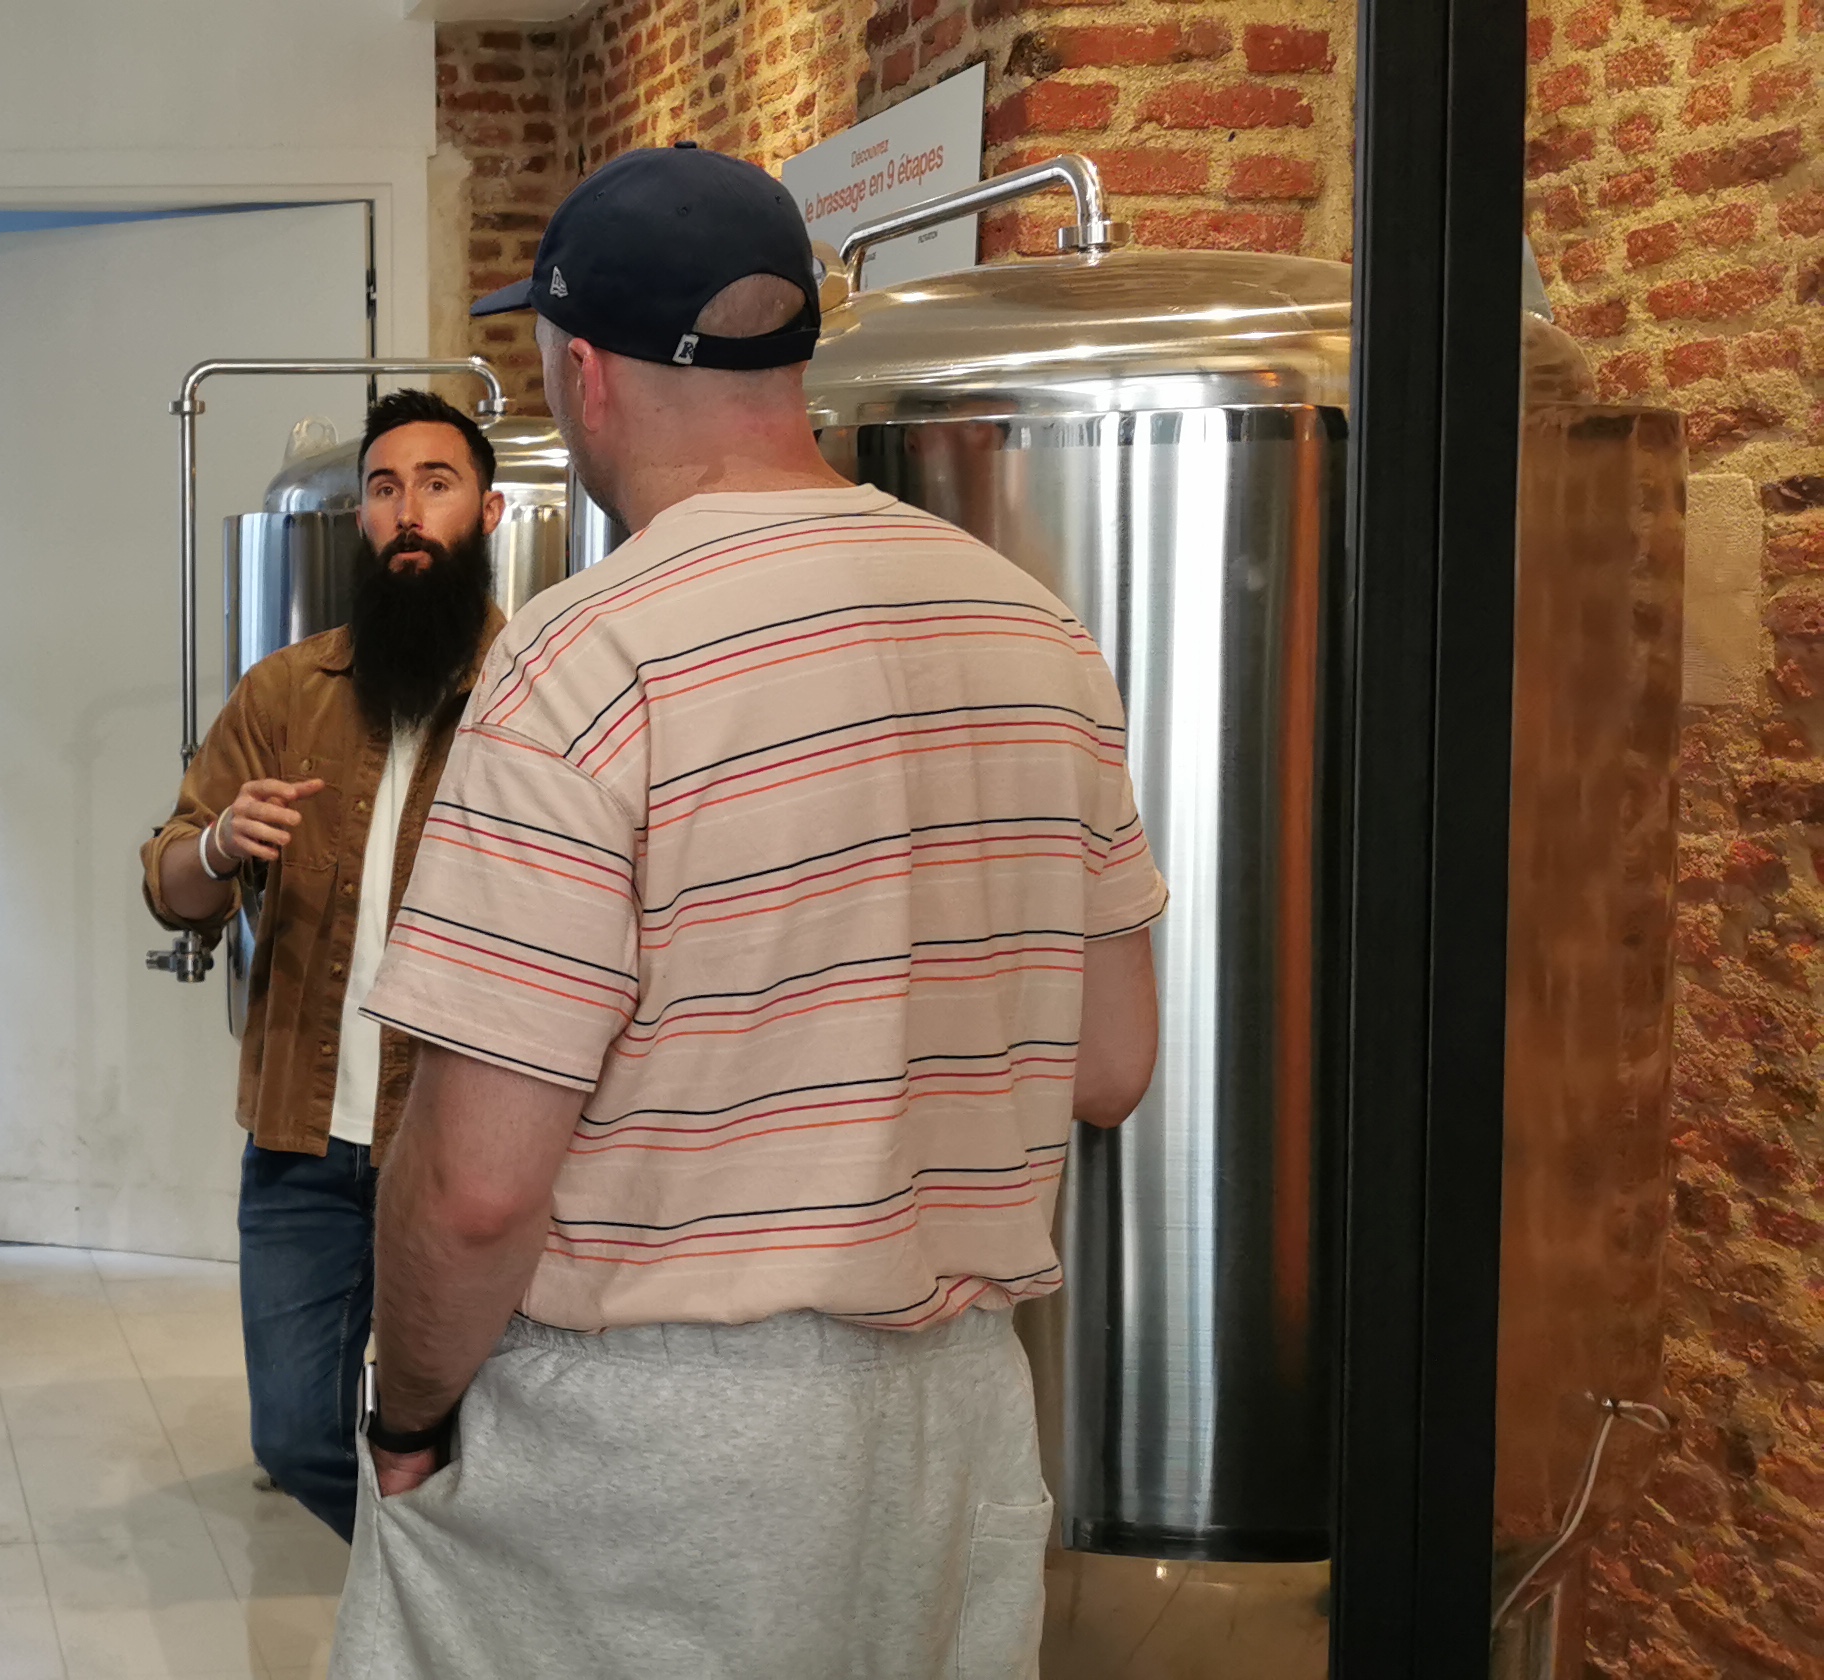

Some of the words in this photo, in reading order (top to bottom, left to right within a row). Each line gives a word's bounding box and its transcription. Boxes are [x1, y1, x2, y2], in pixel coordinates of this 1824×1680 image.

[805, 198, 813, 223] le
[815, 179, 866, 219] brassage
[869, 171, 884, 197] en
[887, 159, 895, 189] 9
[898, 145, 944, 186] étapes
